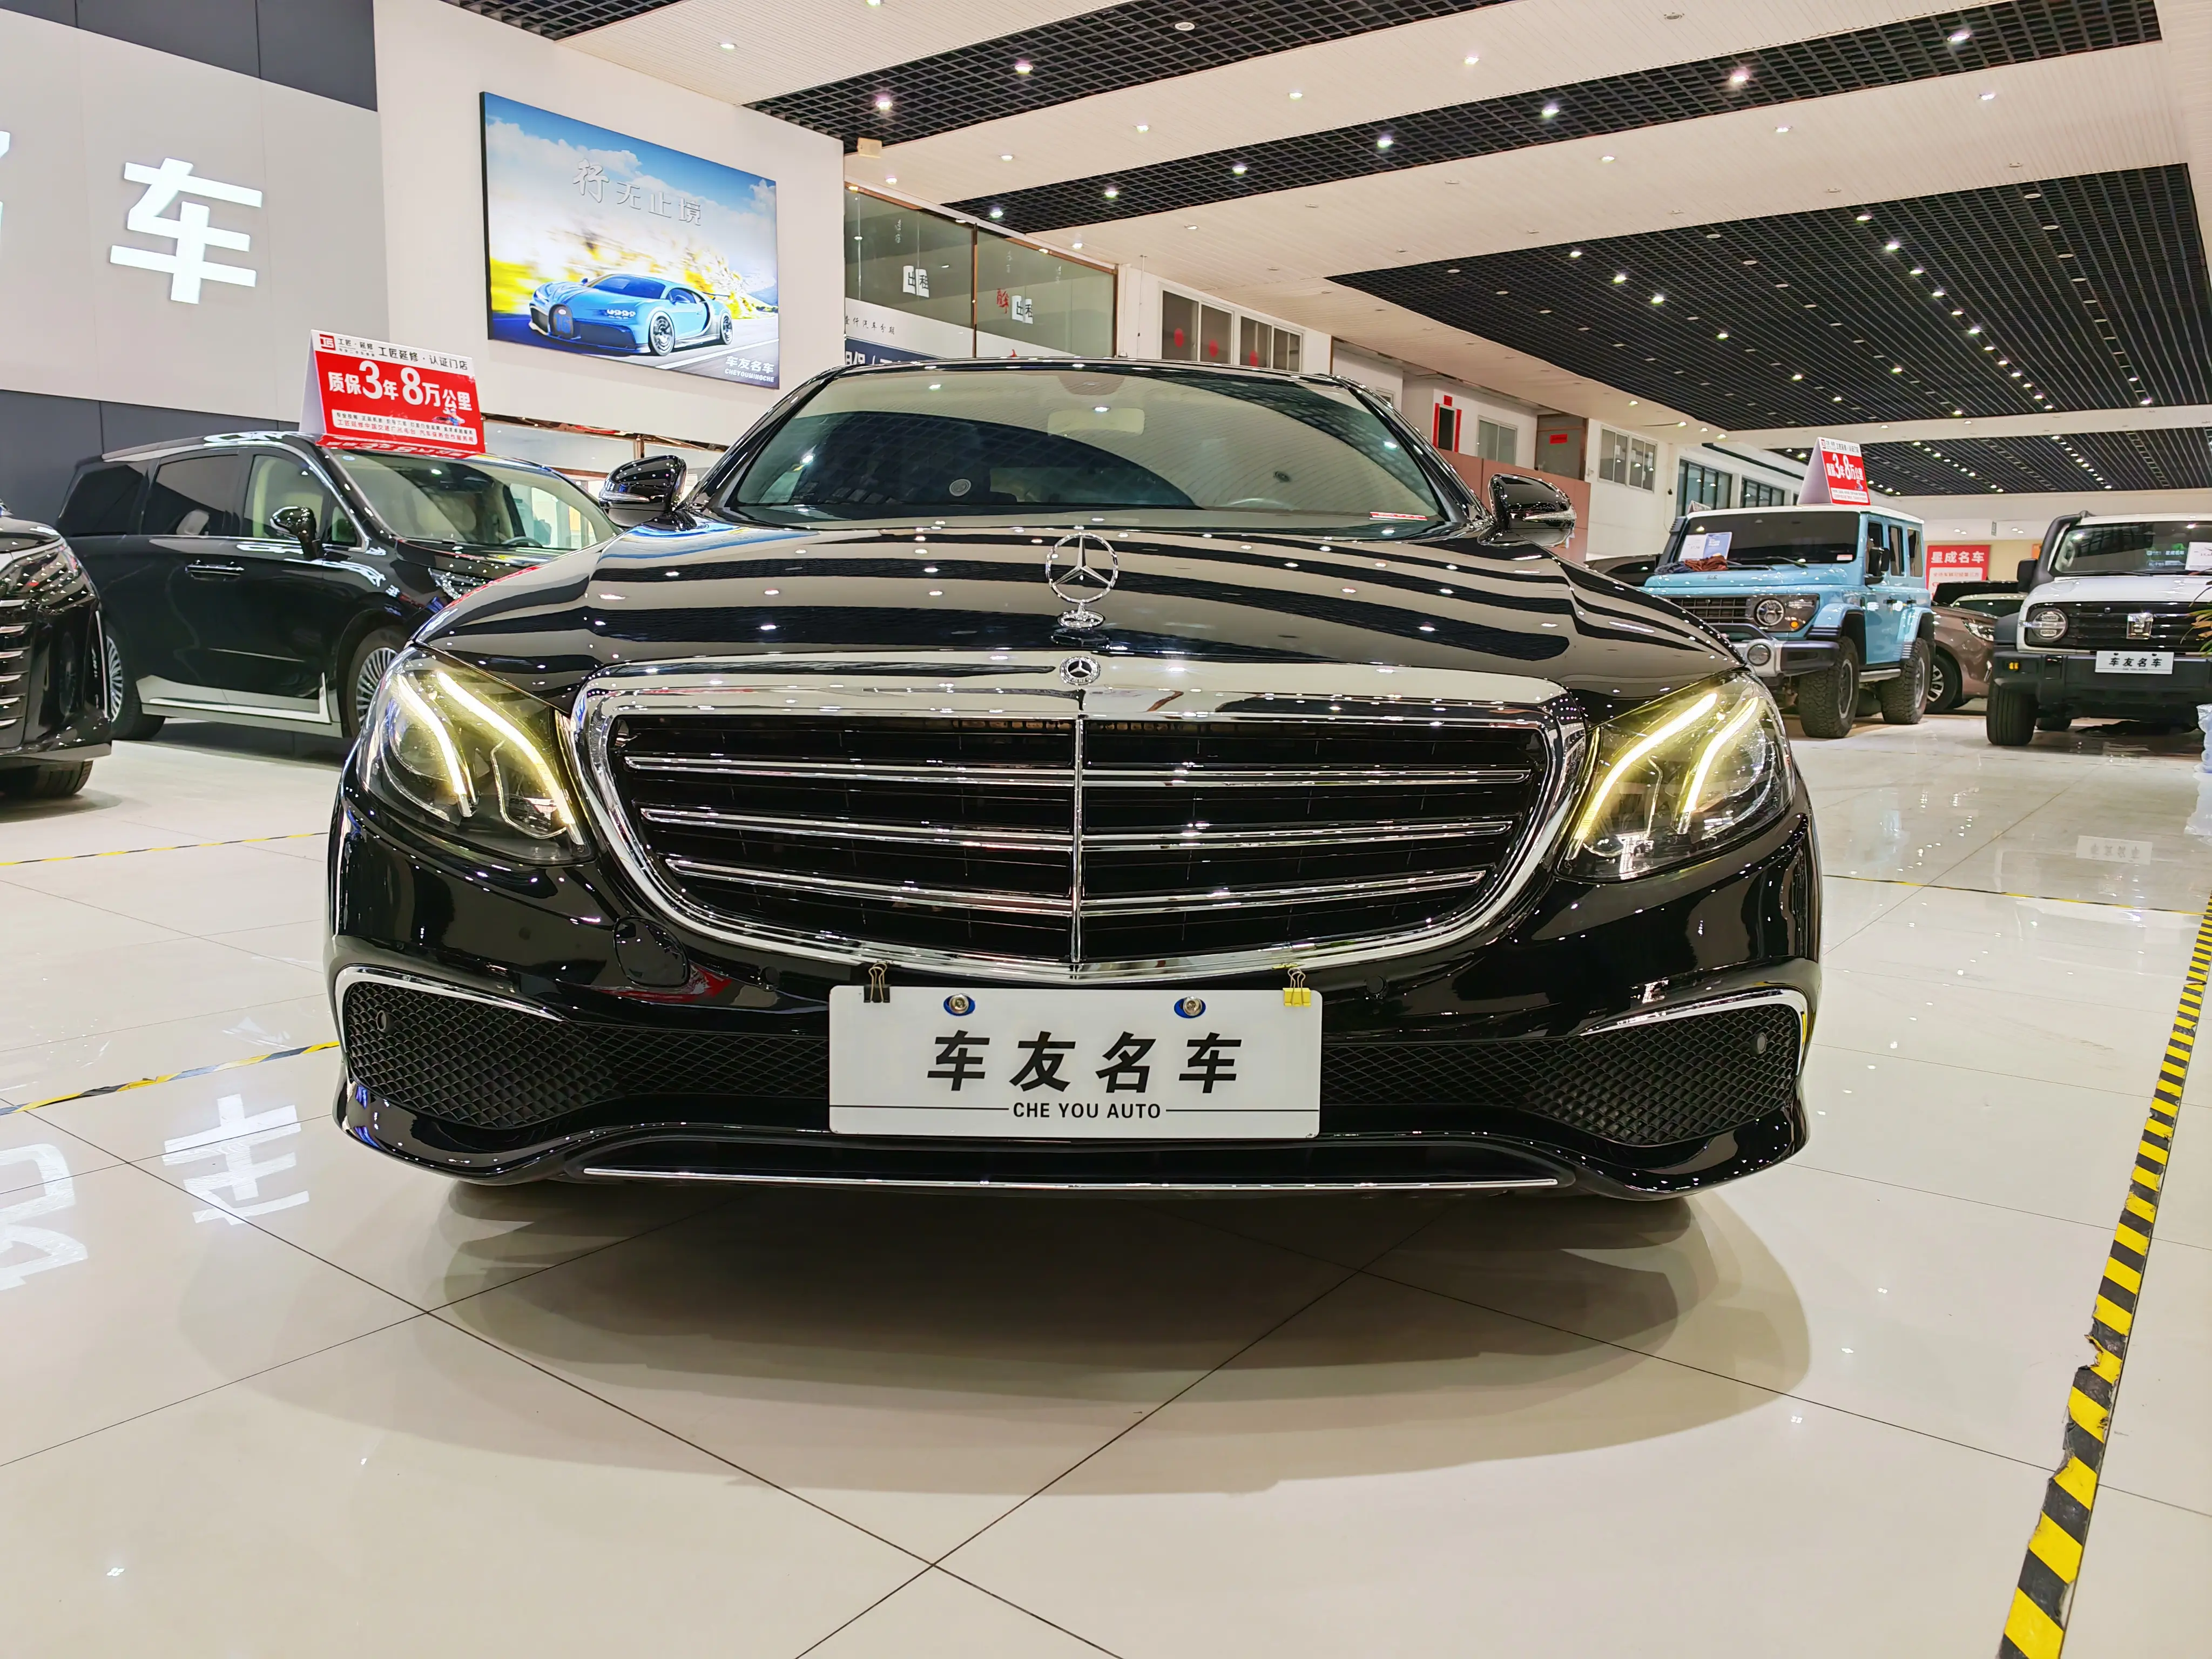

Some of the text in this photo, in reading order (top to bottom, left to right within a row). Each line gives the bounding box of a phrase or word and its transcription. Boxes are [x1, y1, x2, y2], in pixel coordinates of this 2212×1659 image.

[572, 158, 703, 226] 行无止境
[725, 355, 774, 374] 车友名车
[328, 360, 473, 412] 质保3年8万公里
[1931, 551, 1985, 563] 星成名车
[2108, 657, 2163, 667] 车友名车
[927, 1030, 1243, 1094] 车友名车
[1013, 1102, 1161, 1120] CHE YOU AUTO
